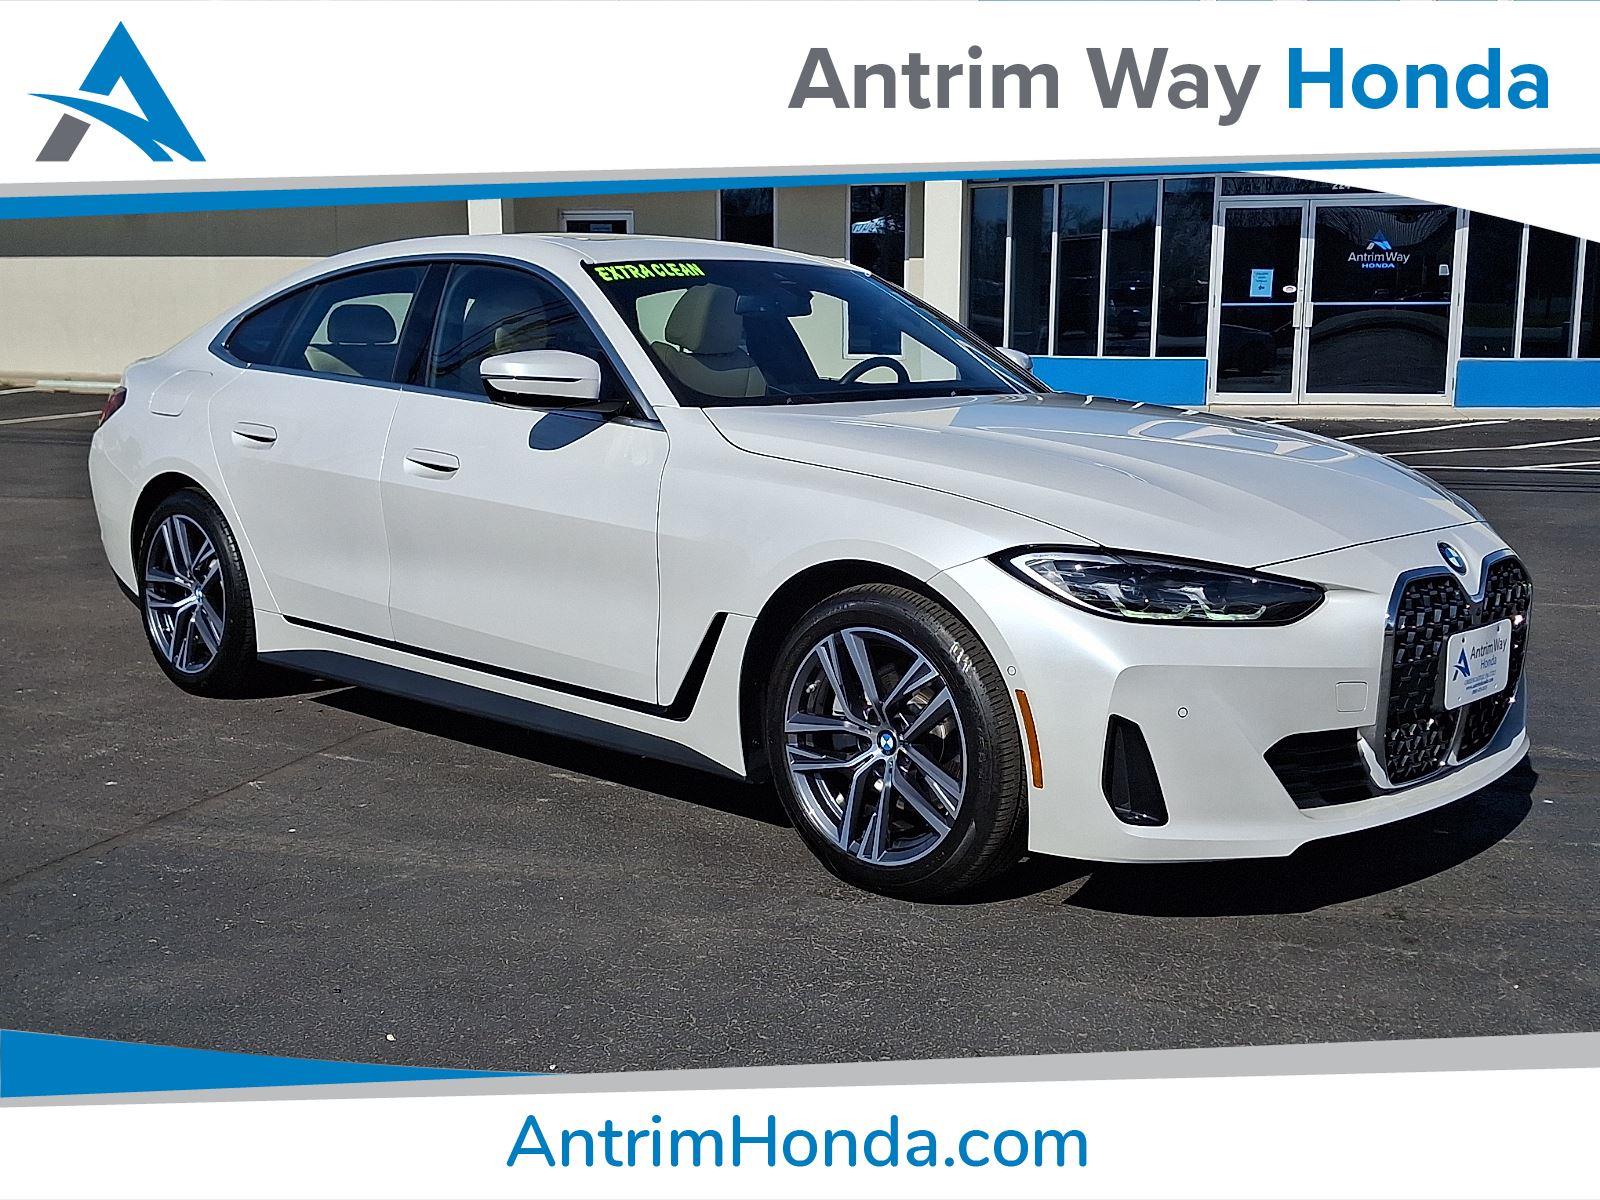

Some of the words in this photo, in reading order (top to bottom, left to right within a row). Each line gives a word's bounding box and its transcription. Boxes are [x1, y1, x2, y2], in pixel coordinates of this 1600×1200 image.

[594, 264, 656, 281] EXTRA
[650, 262, 706, 277] CLEAN
[1480, 656, 1497, 668] Honda
